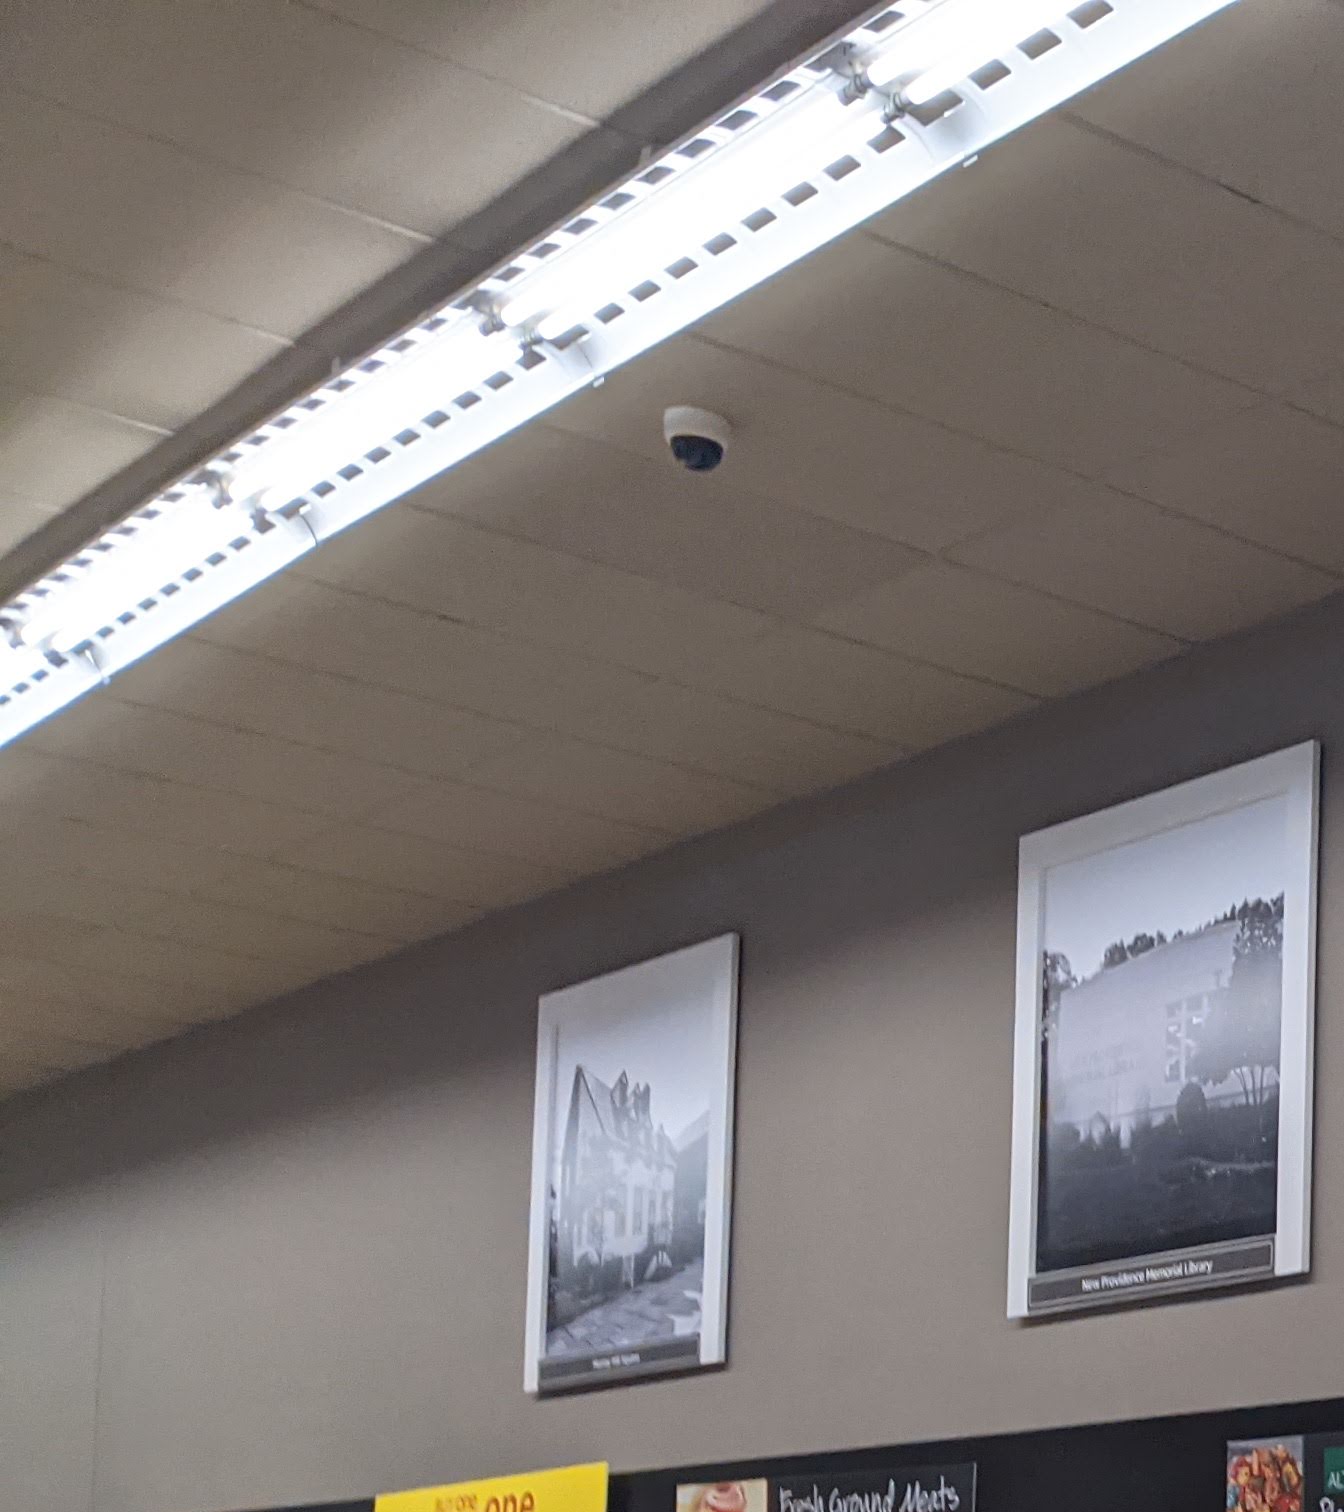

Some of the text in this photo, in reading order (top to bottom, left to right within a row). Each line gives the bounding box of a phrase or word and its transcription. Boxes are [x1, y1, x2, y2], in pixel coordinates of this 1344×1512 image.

[1081, 1278, 1100, 1292] New
[1101, 1270, 1145, 1289] Providence
[1185, 1259, 1213, 1275] Library
